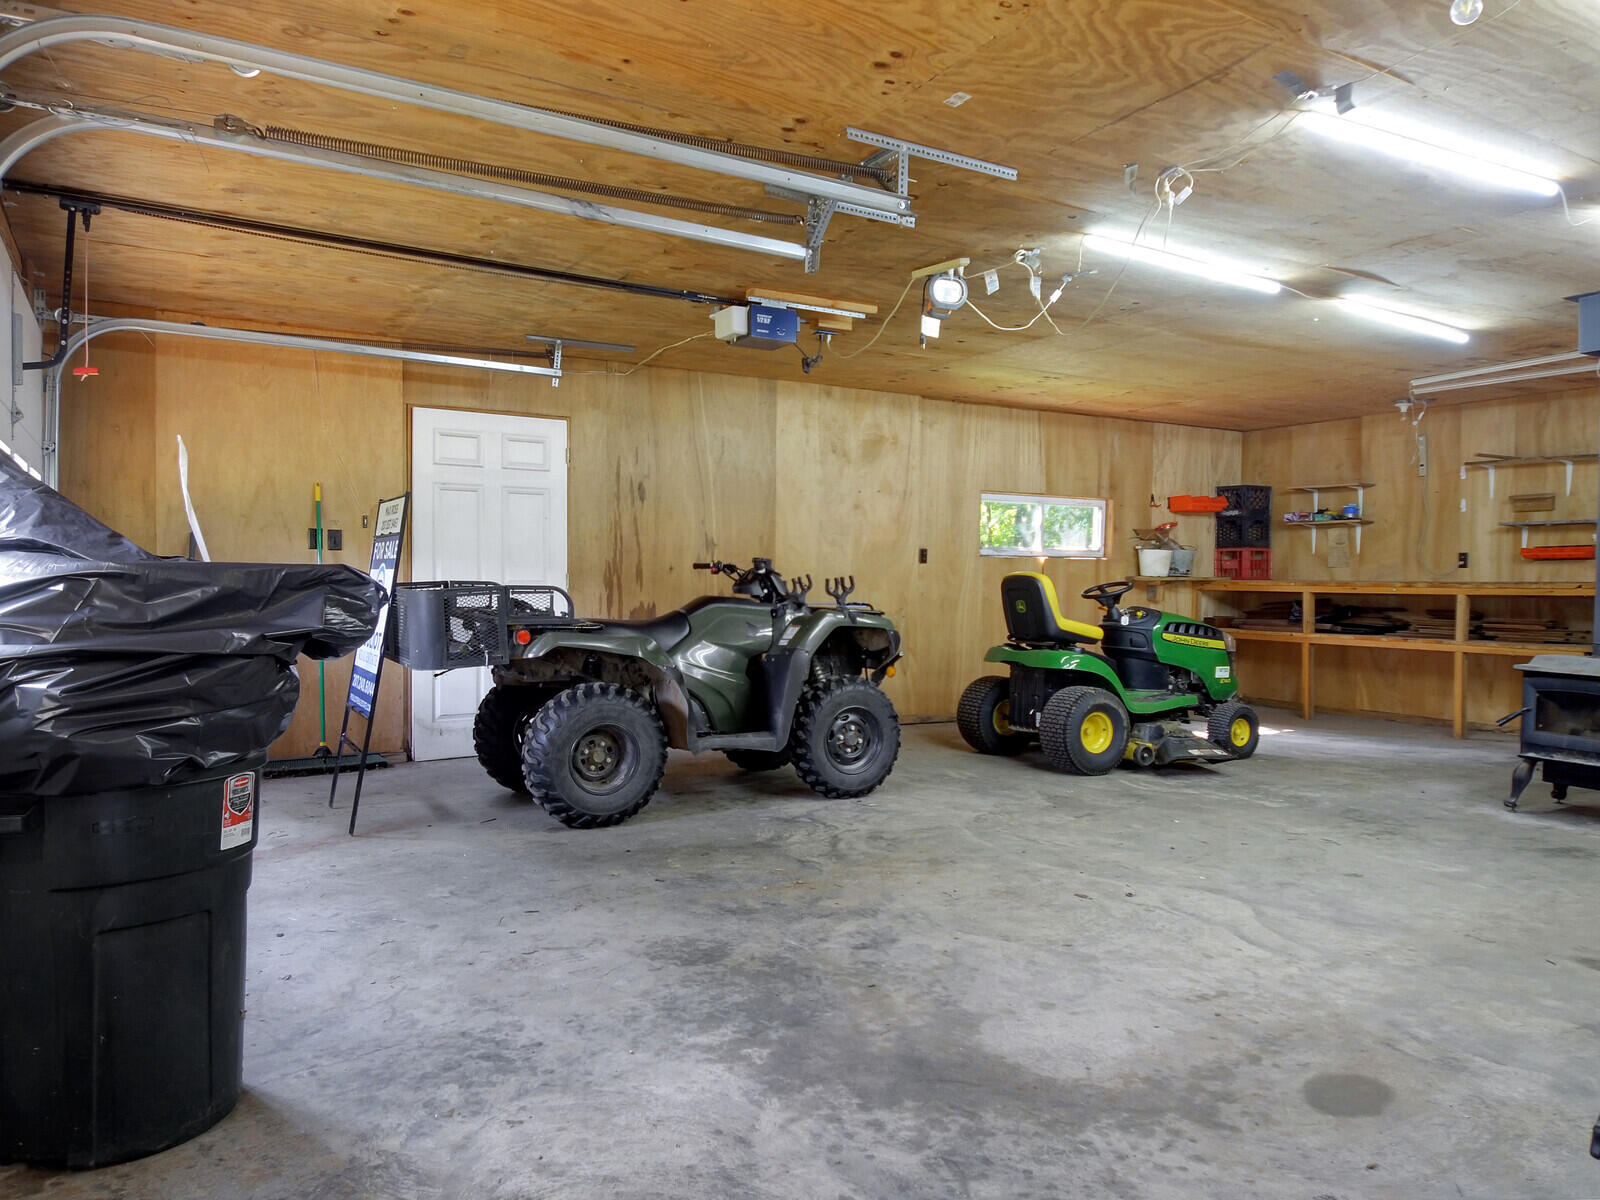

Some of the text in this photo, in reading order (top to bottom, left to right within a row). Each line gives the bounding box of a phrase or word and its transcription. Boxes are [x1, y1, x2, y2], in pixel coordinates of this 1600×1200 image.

[373, 540, 399, 560] FOR SALE
[1173, 635, 1209, 646] JOHN DEERE
